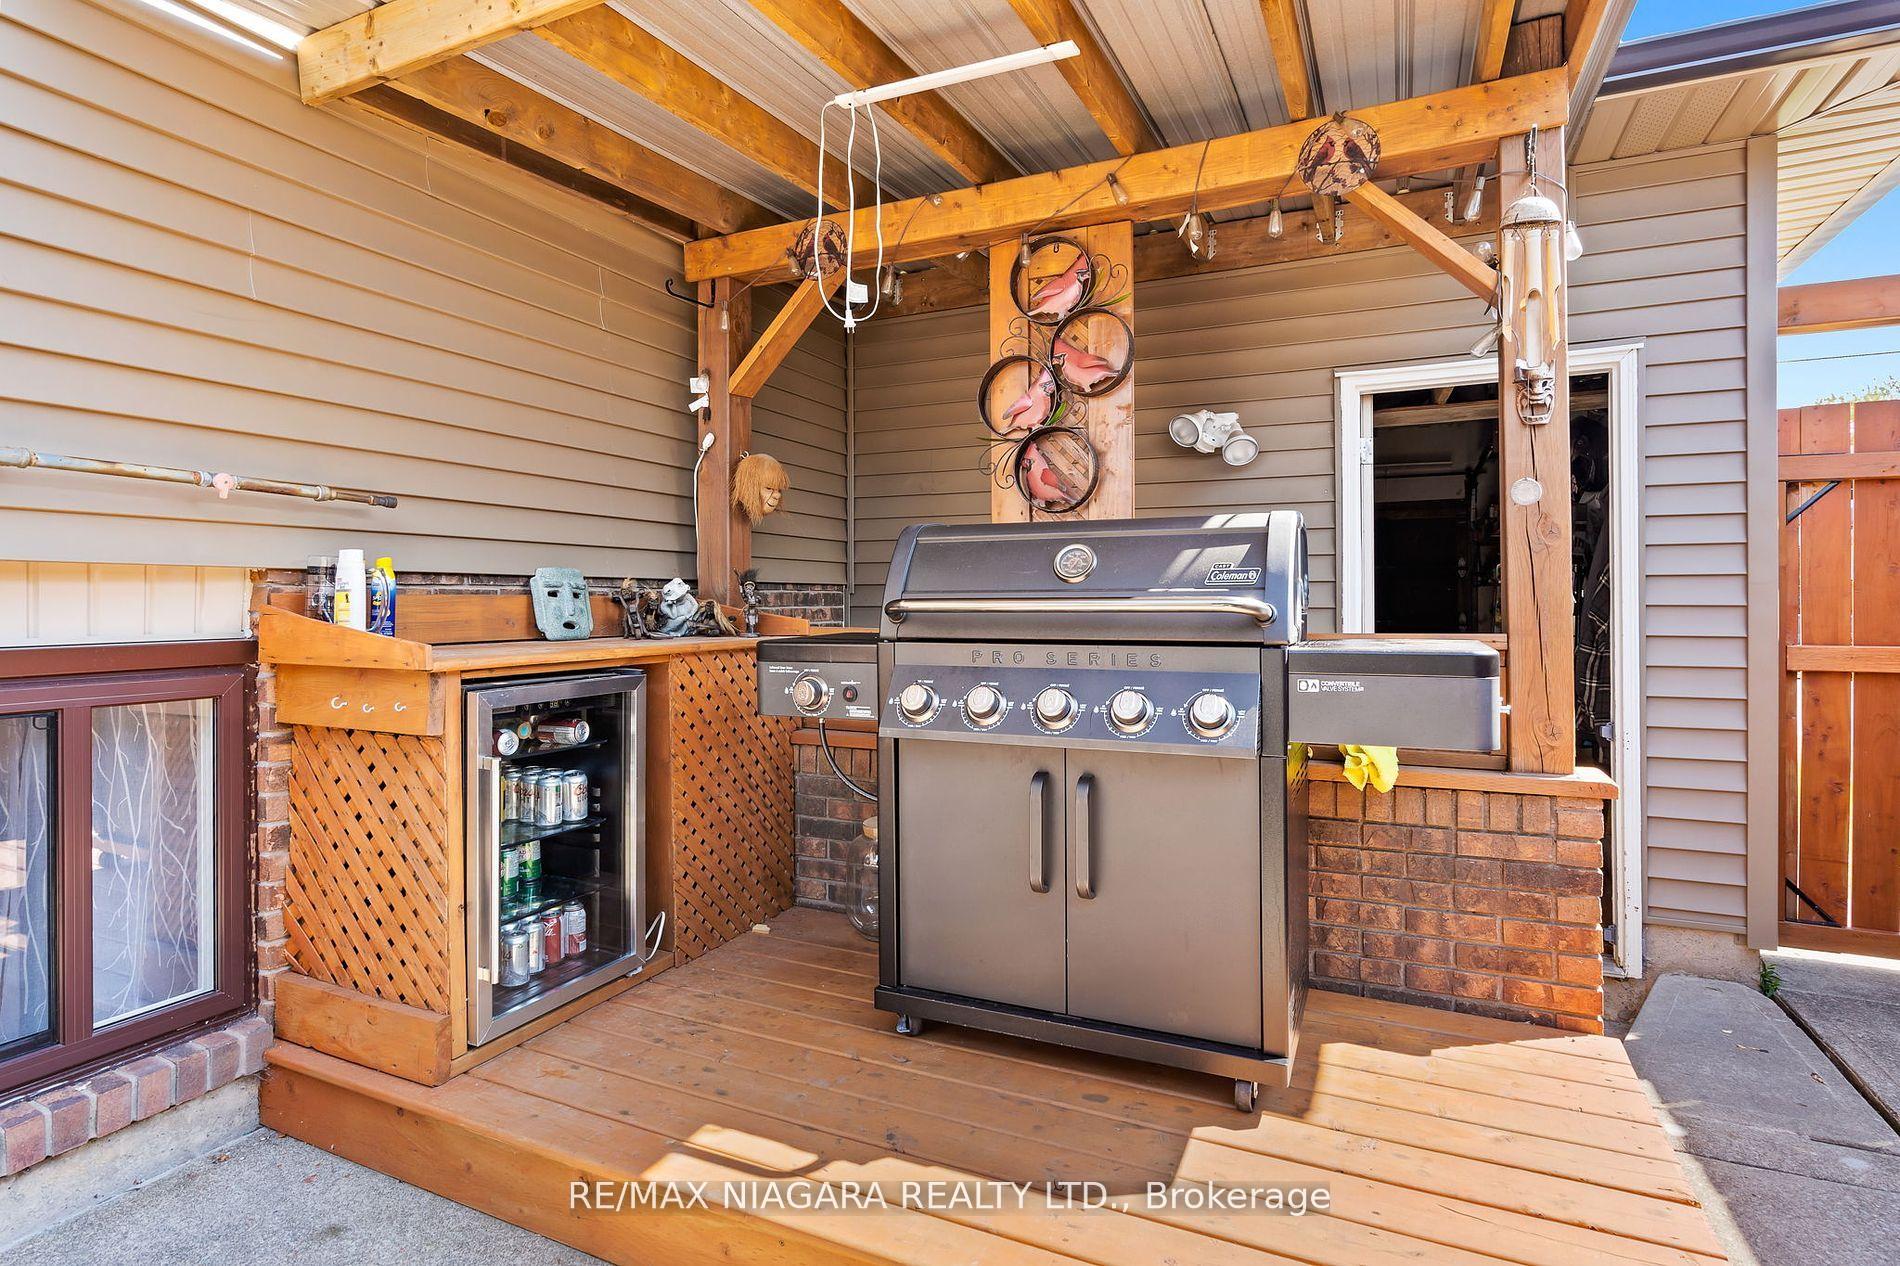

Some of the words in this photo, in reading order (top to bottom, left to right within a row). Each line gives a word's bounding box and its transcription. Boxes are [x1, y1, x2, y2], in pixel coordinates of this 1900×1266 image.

[1210, 570, 1249, 581] Coleman
[971, 650, 1025, 664] PRO
[1046, 651, 1162, 668] SERIES
